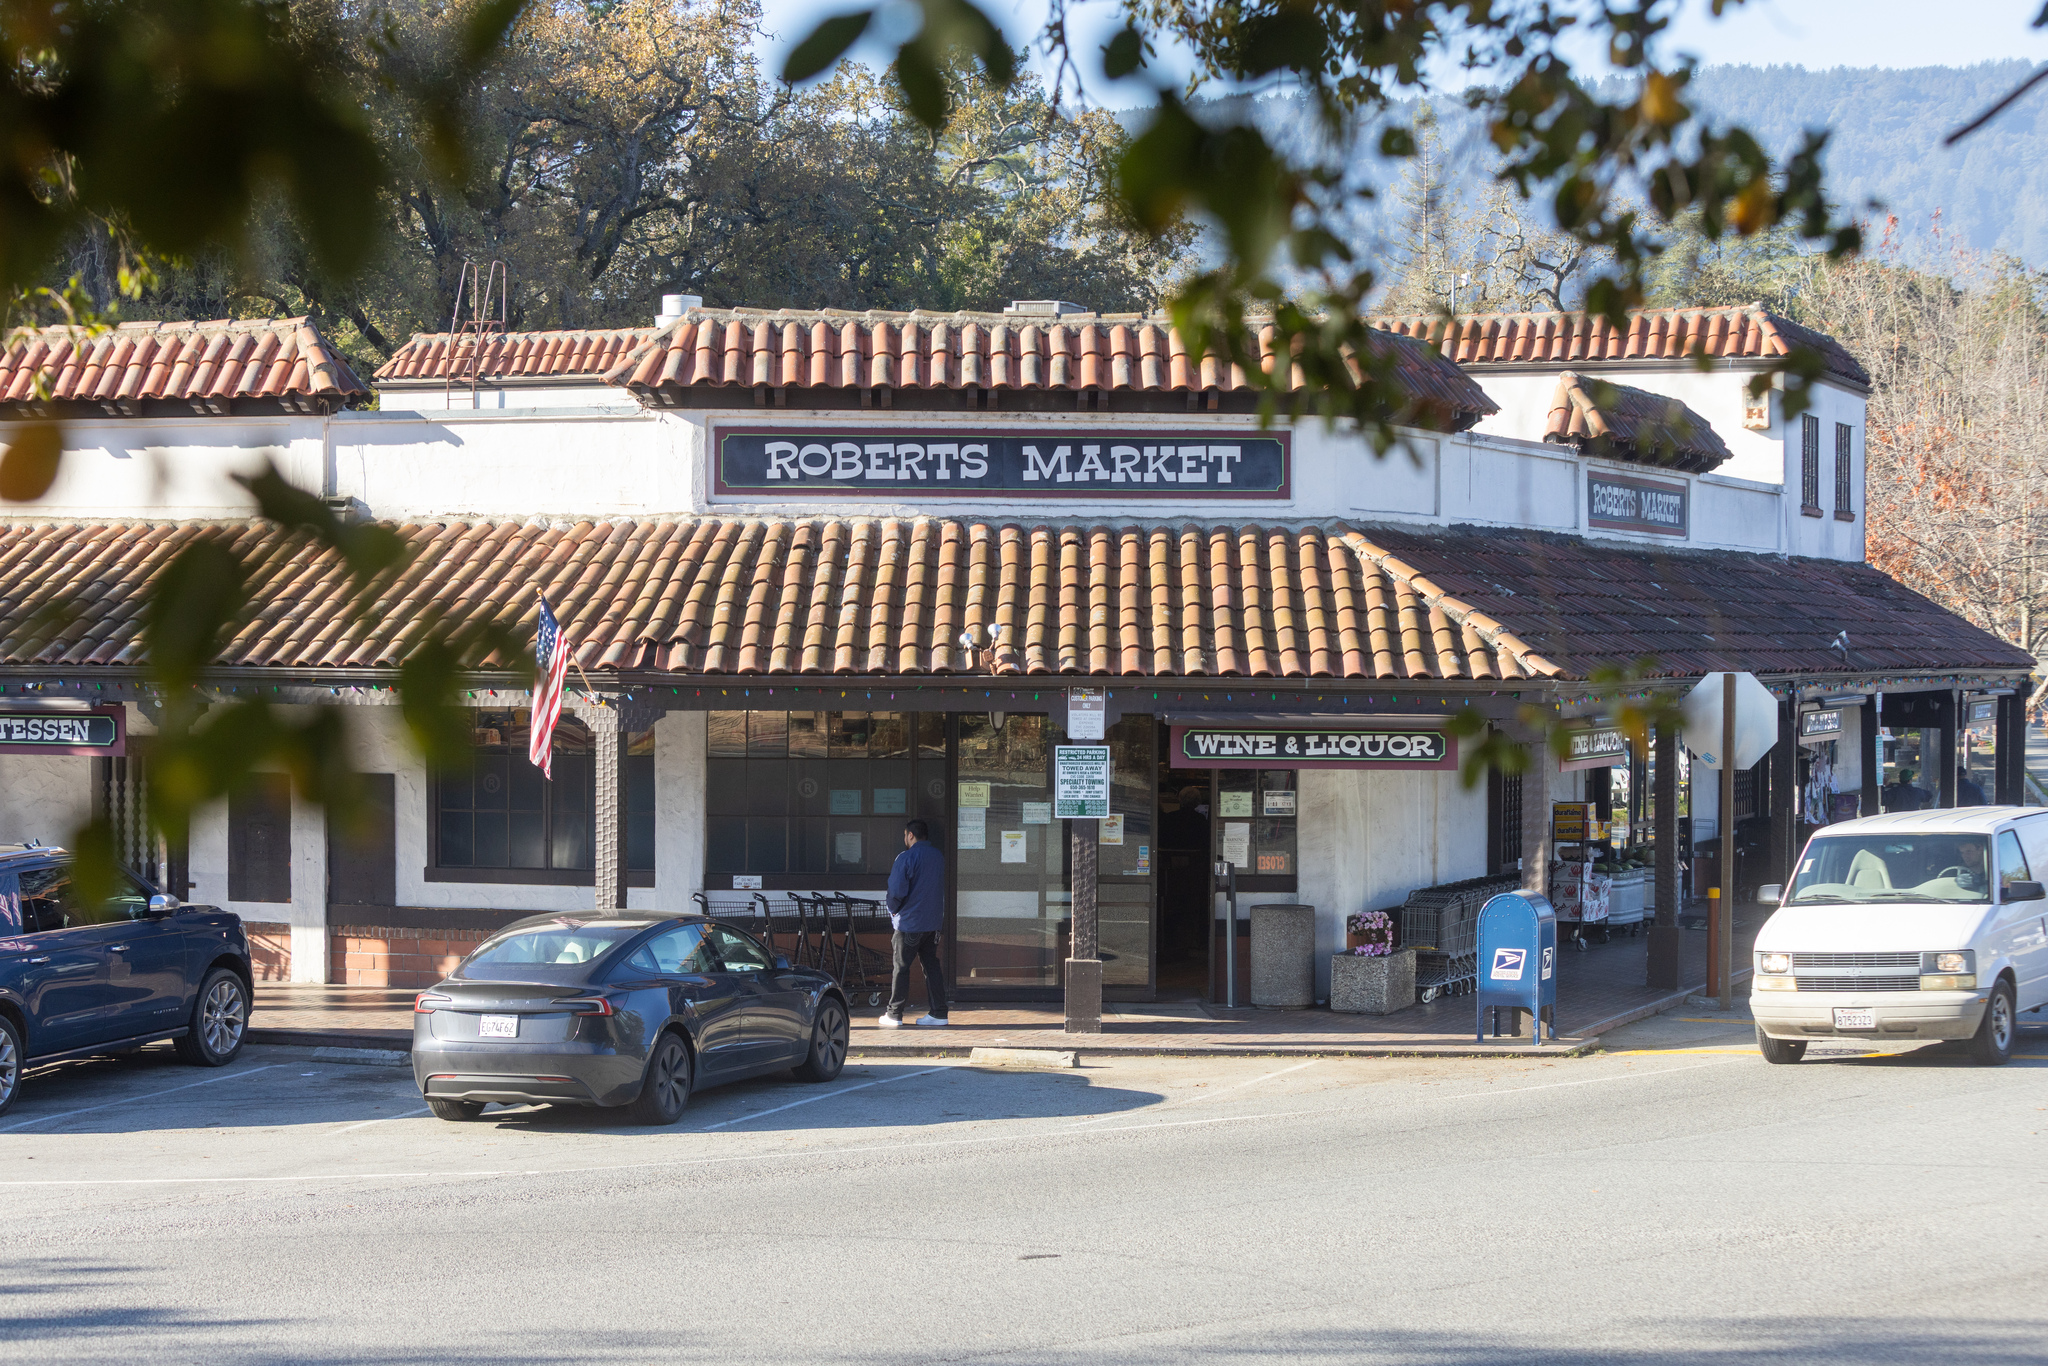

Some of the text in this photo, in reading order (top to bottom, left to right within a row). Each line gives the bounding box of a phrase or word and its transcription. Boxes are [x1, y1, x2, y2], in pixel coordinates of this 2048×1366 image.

[764, 441, 1241, 483] ROBERTS MARKET
[1593, 483, 1680, 523] ROBERTS MARKET
[0, 718, 90, 741] TESSEN
[1194, 735, 1435, 757] WINE & LIQUOR
[1569, 735, 1589, 756] INE
[1593, 730, 1624, 753] LIQUOR
[968, 785, 981, 793] Help
[1554, 807, 1582, 816] duraflame
